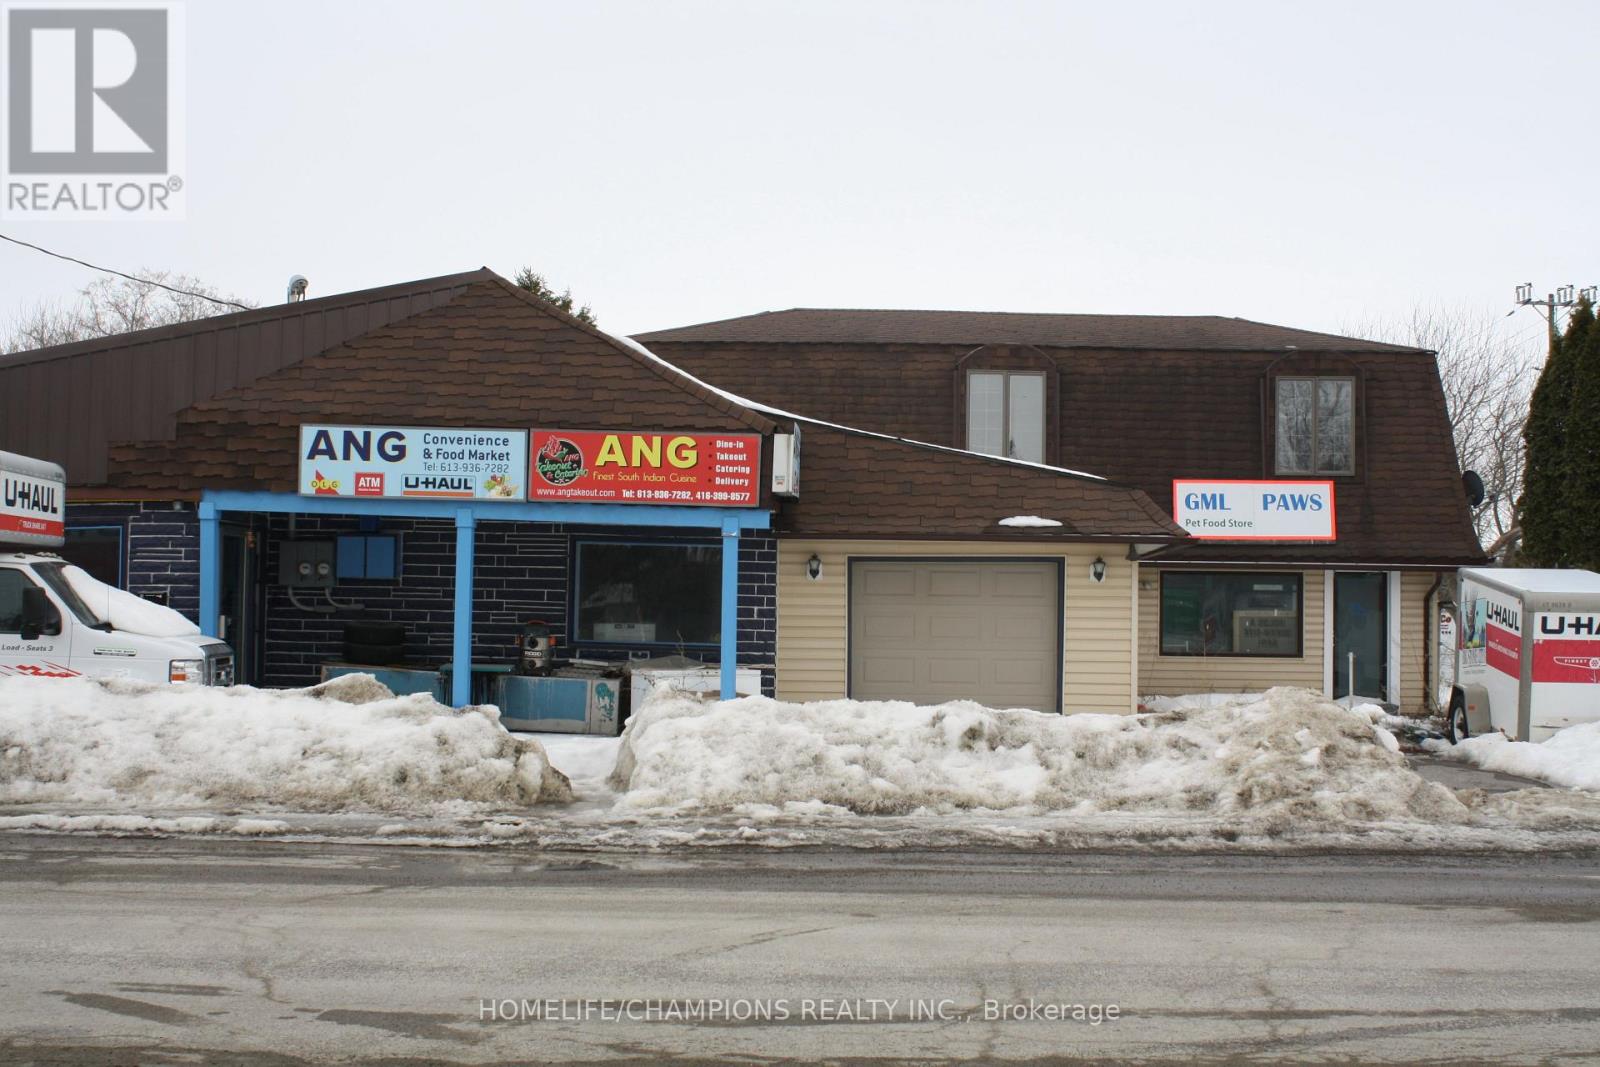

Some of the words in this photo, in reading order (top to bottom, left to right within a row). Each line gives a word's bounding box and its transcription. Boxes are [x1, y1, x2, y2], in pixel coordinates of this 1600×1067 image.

[306, 429, 407, 463] ANG
[423, 433, 510, 446] Convenience
[423, 448, 432, 460] &
[436, 449, 465, 460] Food
[468, 449, 511, 461] Market
[594, 434, 698, 469] ANG
[716, 452, 747, 461] Takeout
[423, 462, 438, 471] Tel:
[440, 463, 509, 473] 613-936-7282
[715, 464, 751, 475] Catering
[358, 477, 381, 488] ATM
[404, 476, 473, 490] U-HAUL
[592, 471, 614, 482] Finest
[618, 472, 640, 482] South
[642, 473, 666, 483] Indian
[669, 473, 697, 483] Cuisine
[715, 476, 749, 487] Delivery
[5, 478, 58, 514] U-HAUL
[536, 486, 616, 497] www.angtakeout.com
[1184, 492, 1231, 511] GML
[1262, 493, 1323, 511] PAWS
[1185, 518, 1201, 527] Pet
[1203, 518, 1226, 528] Food
[1228, 518, 1253, 528] Store
[1486, 600, 1520, 631] U-HAUL
[1541, 615, 1600, 635] U-H
